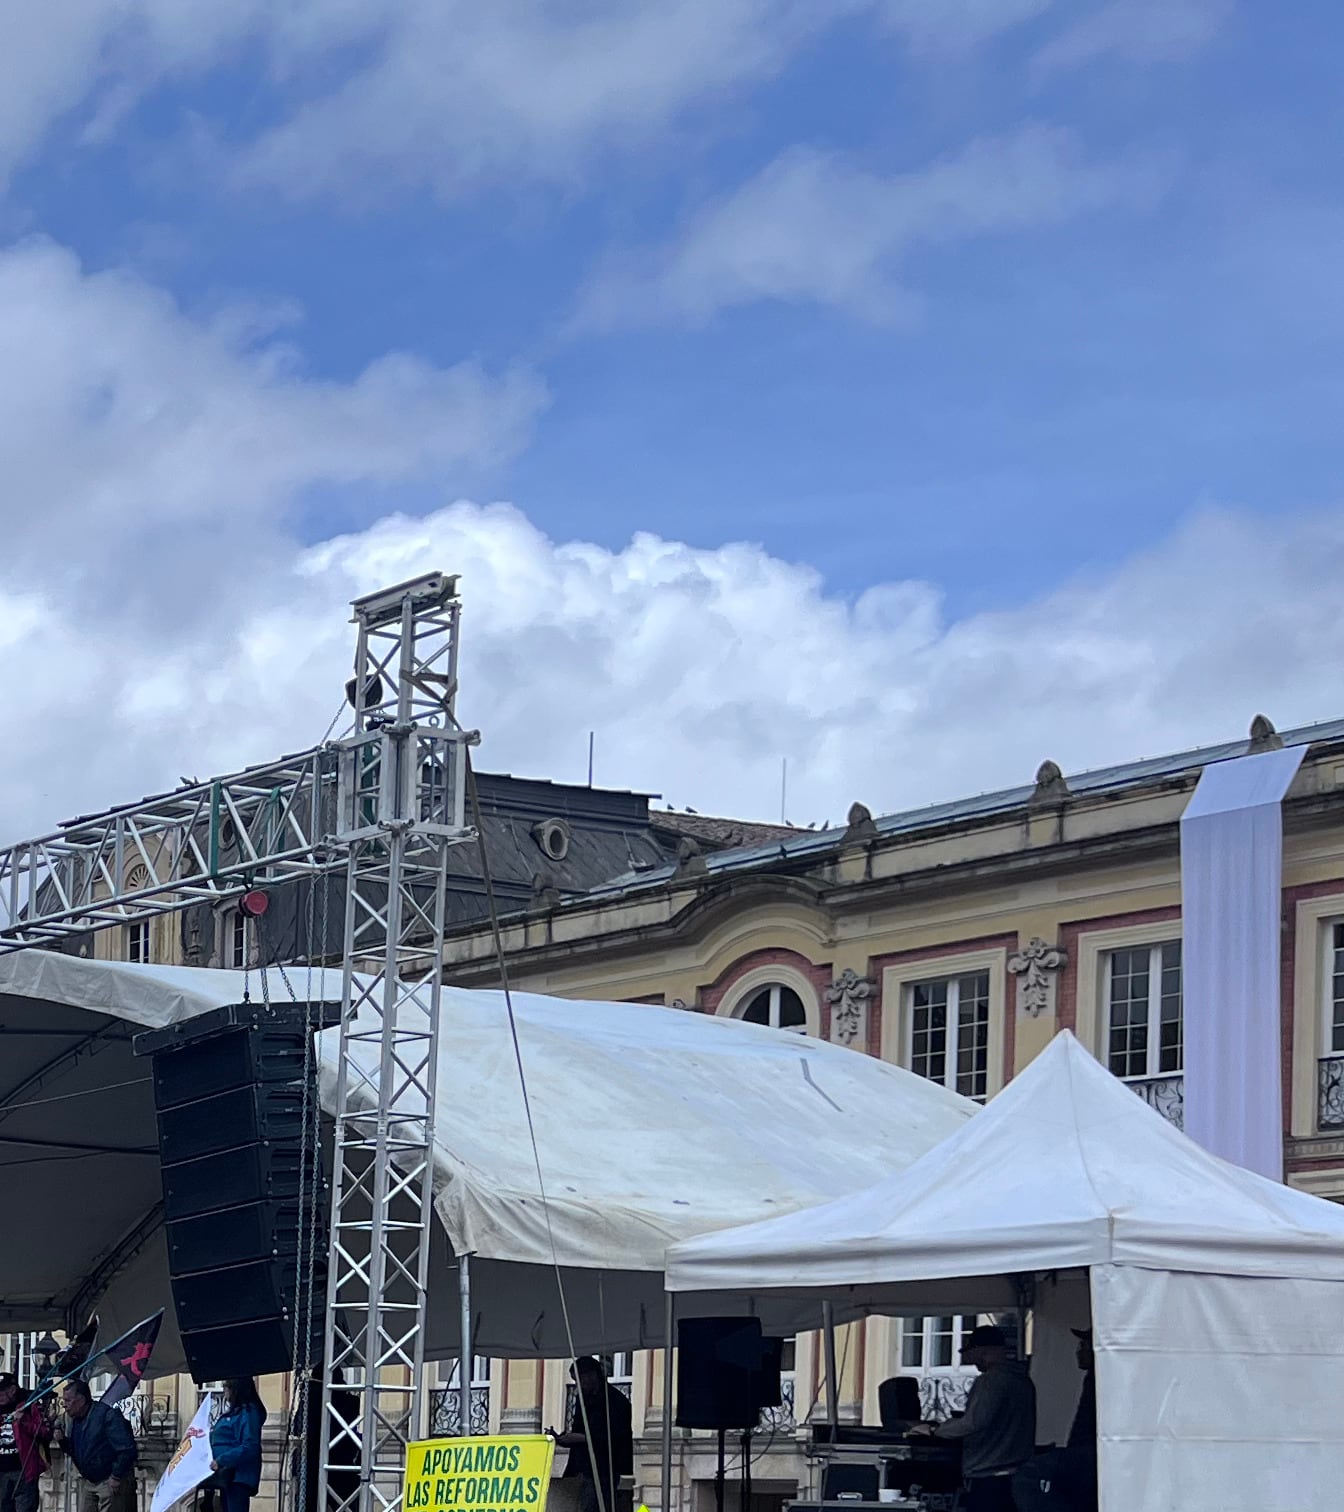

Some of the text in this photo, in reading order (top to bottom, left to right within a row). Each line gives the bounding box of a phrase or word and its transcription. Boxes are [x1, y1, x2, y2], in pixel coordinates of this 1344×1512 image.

[421, 1445, 521, 1476] APOYAMOS
[406, 1477, 540, 1508] LAS REFORMAS
